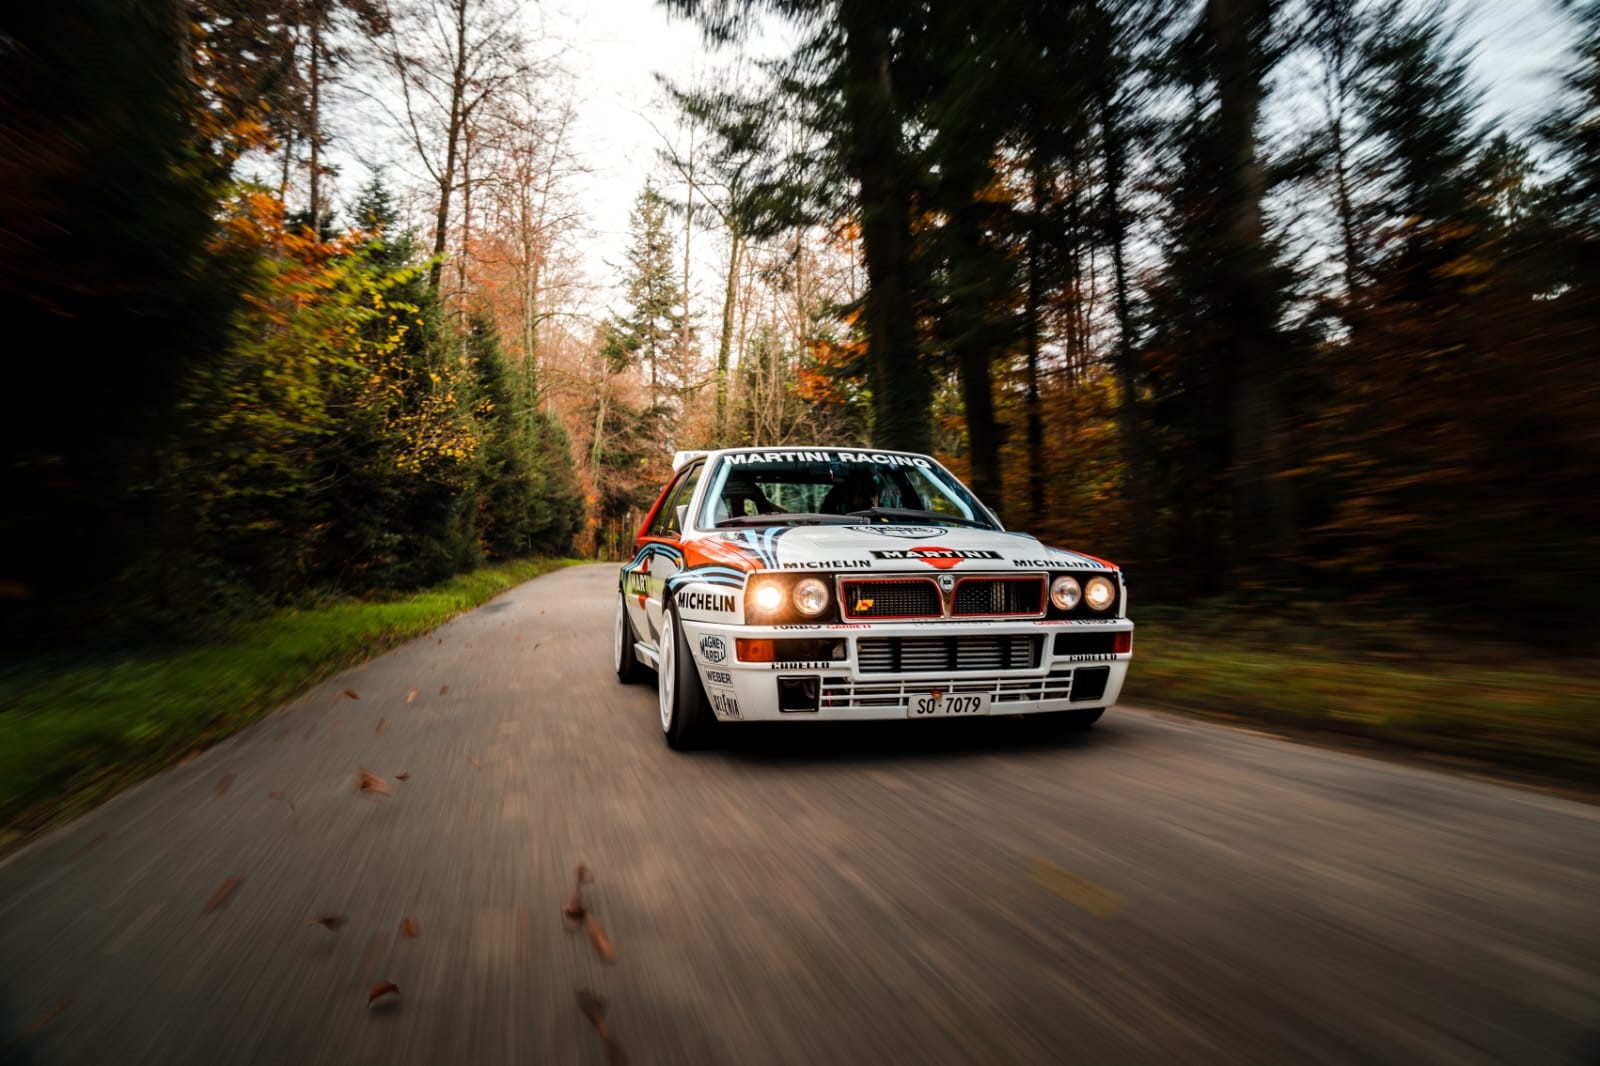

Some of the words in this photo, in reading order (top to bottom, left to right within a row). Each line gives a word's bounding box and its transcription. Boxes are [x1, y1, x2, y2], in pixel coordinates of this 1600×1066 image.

[723, 451, 830, 465] MARTINI
[838, 453, 931, 469] RACING
[884, 550, 992, 559] MARTINI
[783, 559, 872, 569] MICHELIN
[1013, 559, 1090, 568] MICHELIN
[678, 592, 736, 612] MICHELIN
[705, 670, 732, 684] WEBER
